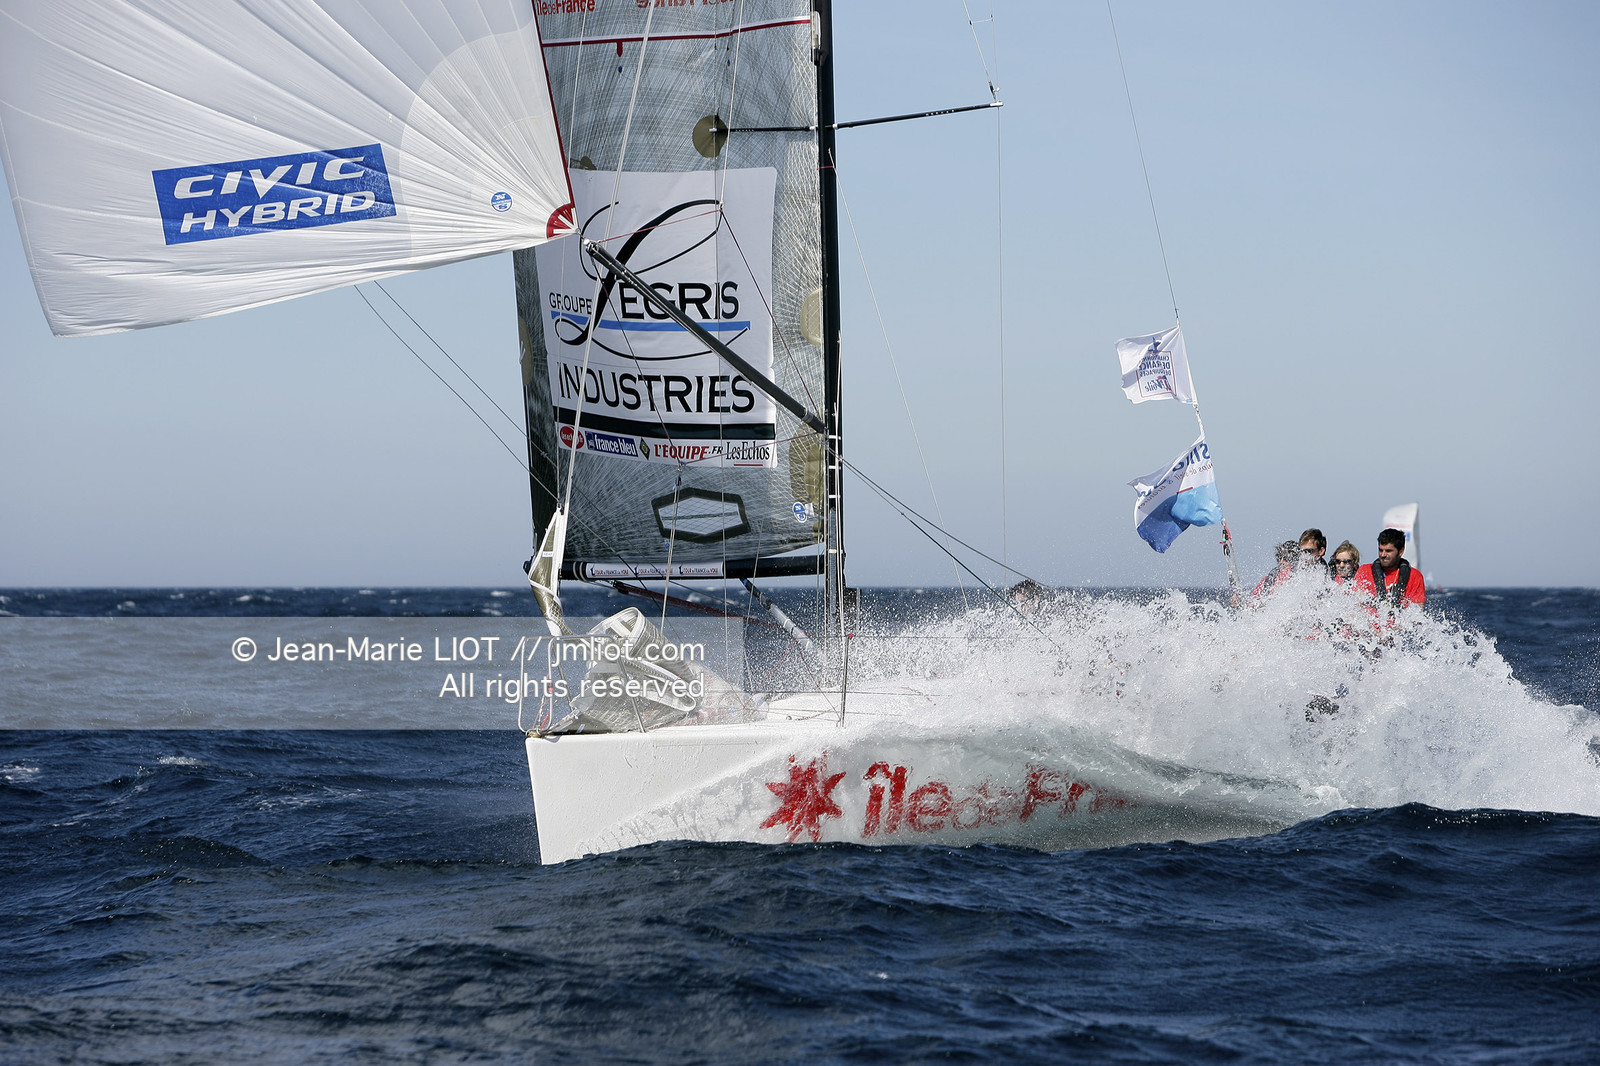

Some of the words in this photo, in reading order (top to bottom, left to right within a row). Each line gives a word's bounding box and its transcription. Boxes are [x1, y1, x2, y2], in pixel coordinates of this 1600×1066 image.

[174, 156, 365, 200] CIVIC
[180, 191, 376, 233] HYBRID
[549, 292, 592, 315] GROUPE
[556, 361, 755, 413] INDUSTRIES
